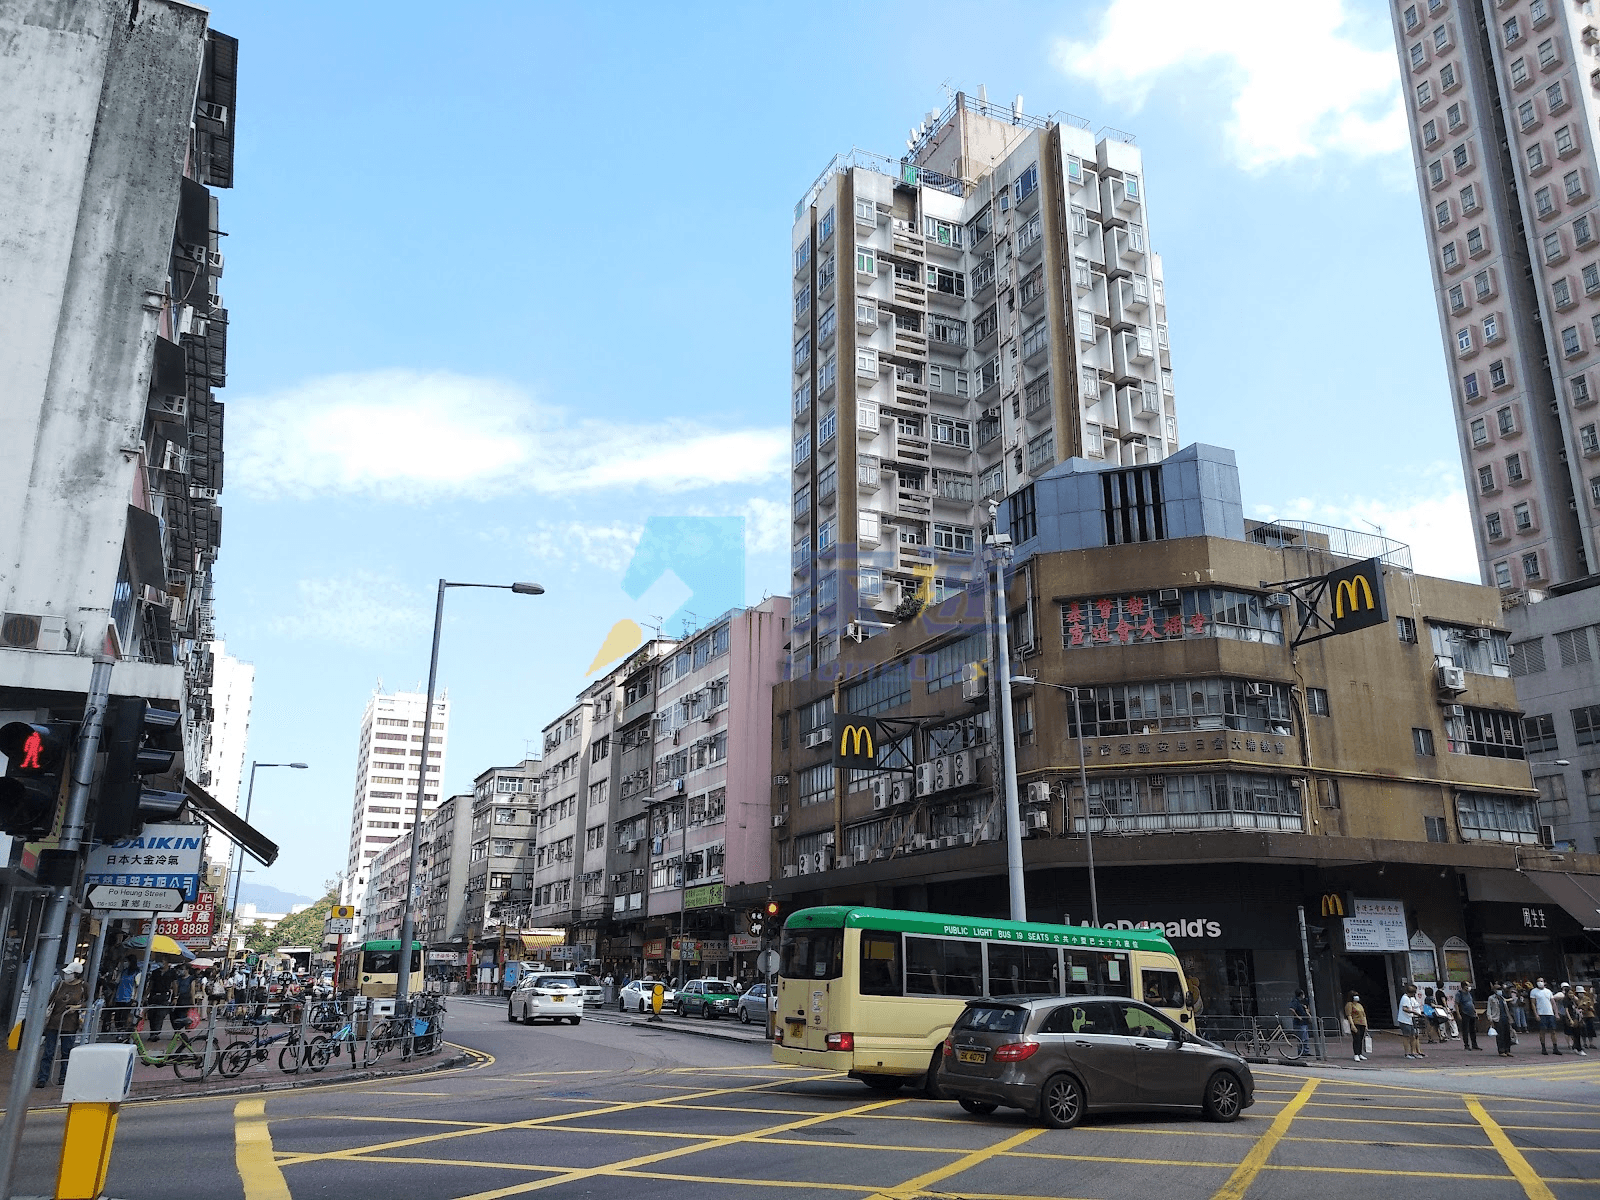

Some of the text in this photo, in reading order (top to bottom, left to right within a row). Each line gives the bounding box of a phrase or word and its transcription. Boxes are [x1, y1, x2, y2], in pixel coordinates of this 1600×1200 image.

[1066, 596, 1145, 623] 基督教
[111, 837, 201, 849] DAIKIN
[107, 855, 179, 865] 日本大金冷氣
[120, 888, 143, 898] Heung
[144, 890, 167, 898] Street
[121, 899, 151, 908] 寶鄉街
[1521, 907, 1547, 928] 周生生
[181, 923, 209, 935] 8888
[1080, 918, 1222, 938] Dnald's
[943, 925, 1139, 949] PUBLIC LIGHT BUS 19 SEATS 公共小型巴士十九座位
